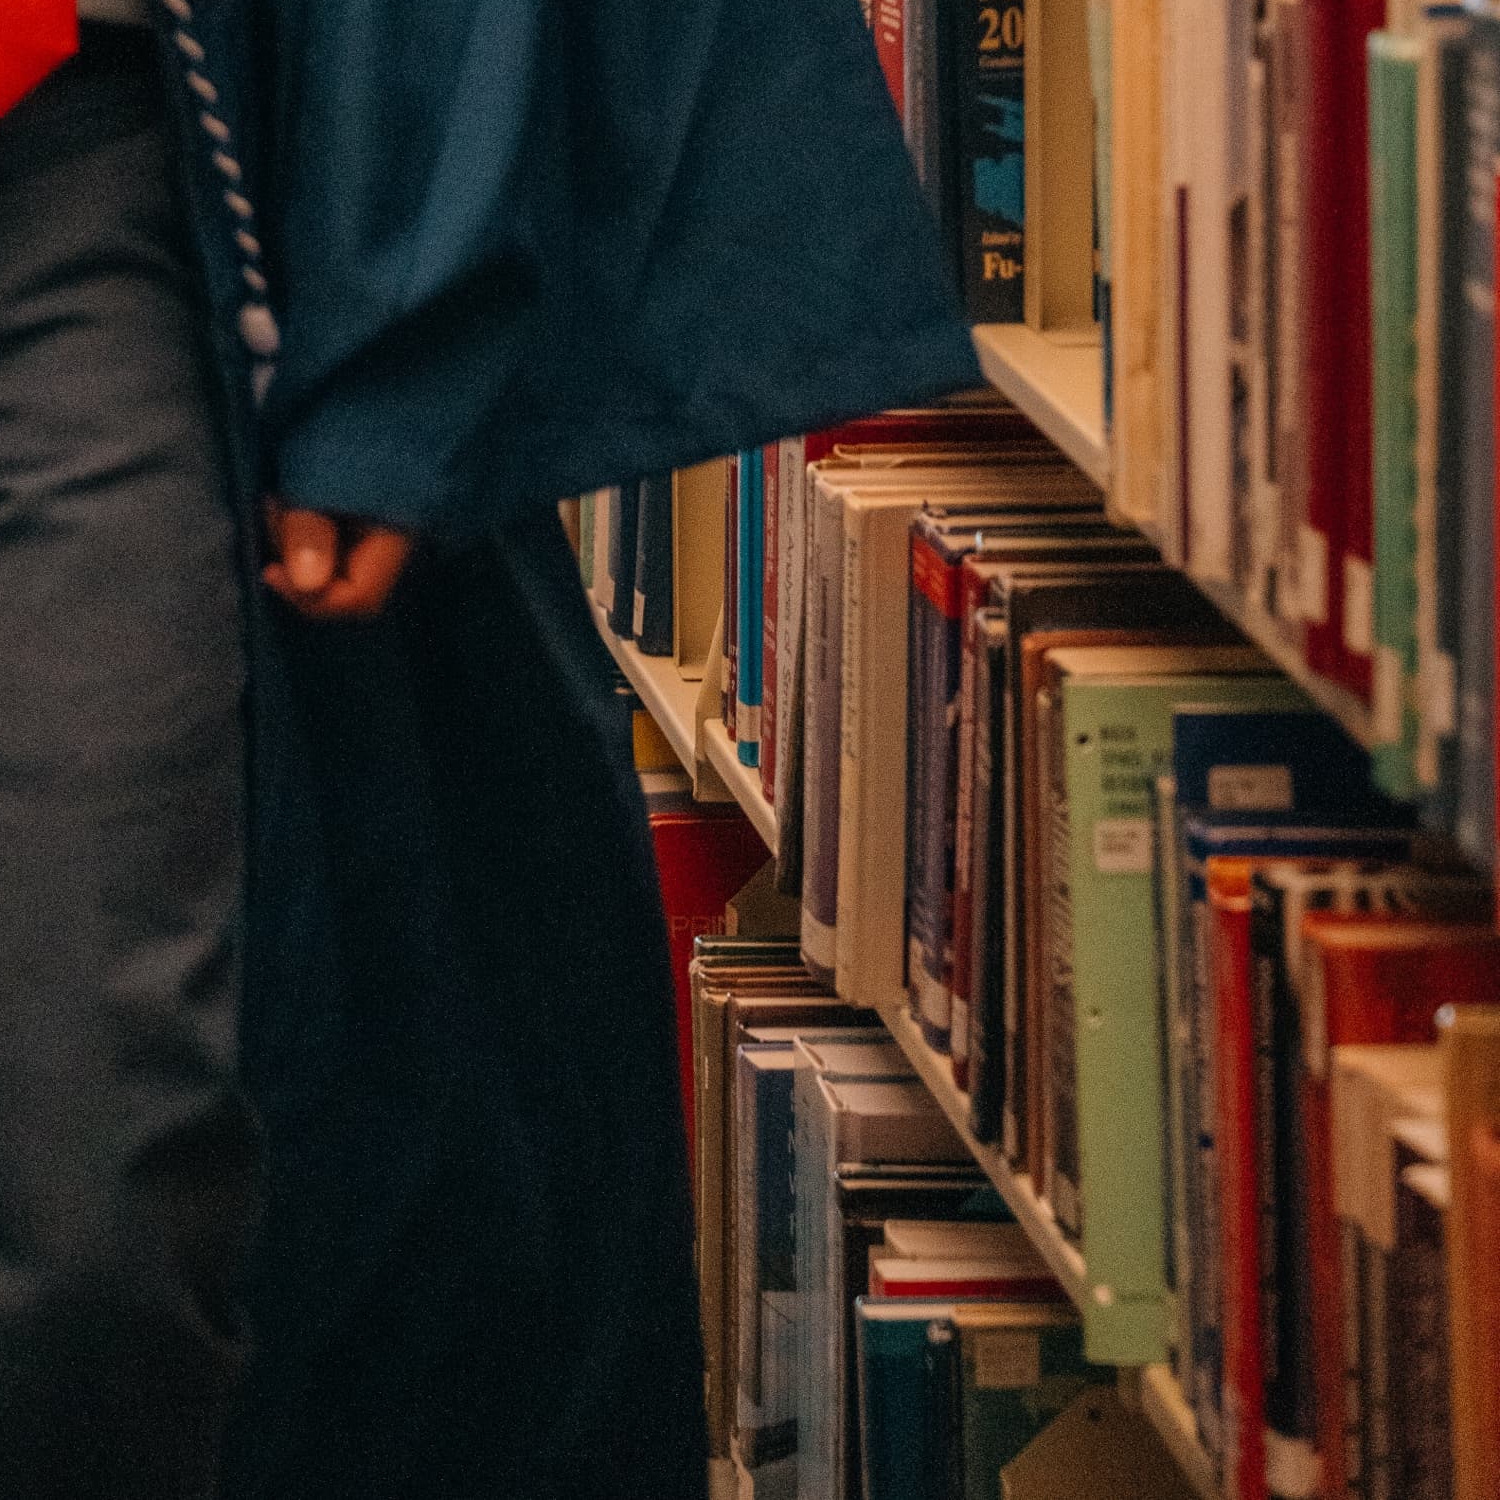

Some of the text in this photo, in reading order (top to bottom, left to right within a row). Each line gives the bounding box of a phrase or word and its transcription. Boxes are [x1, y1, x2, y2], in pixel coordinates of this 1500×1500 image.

[978, 7, 1025, 51] 20
[786, 453, 797, 521] Elastic
[784, 534, 796, 622] Analysis
